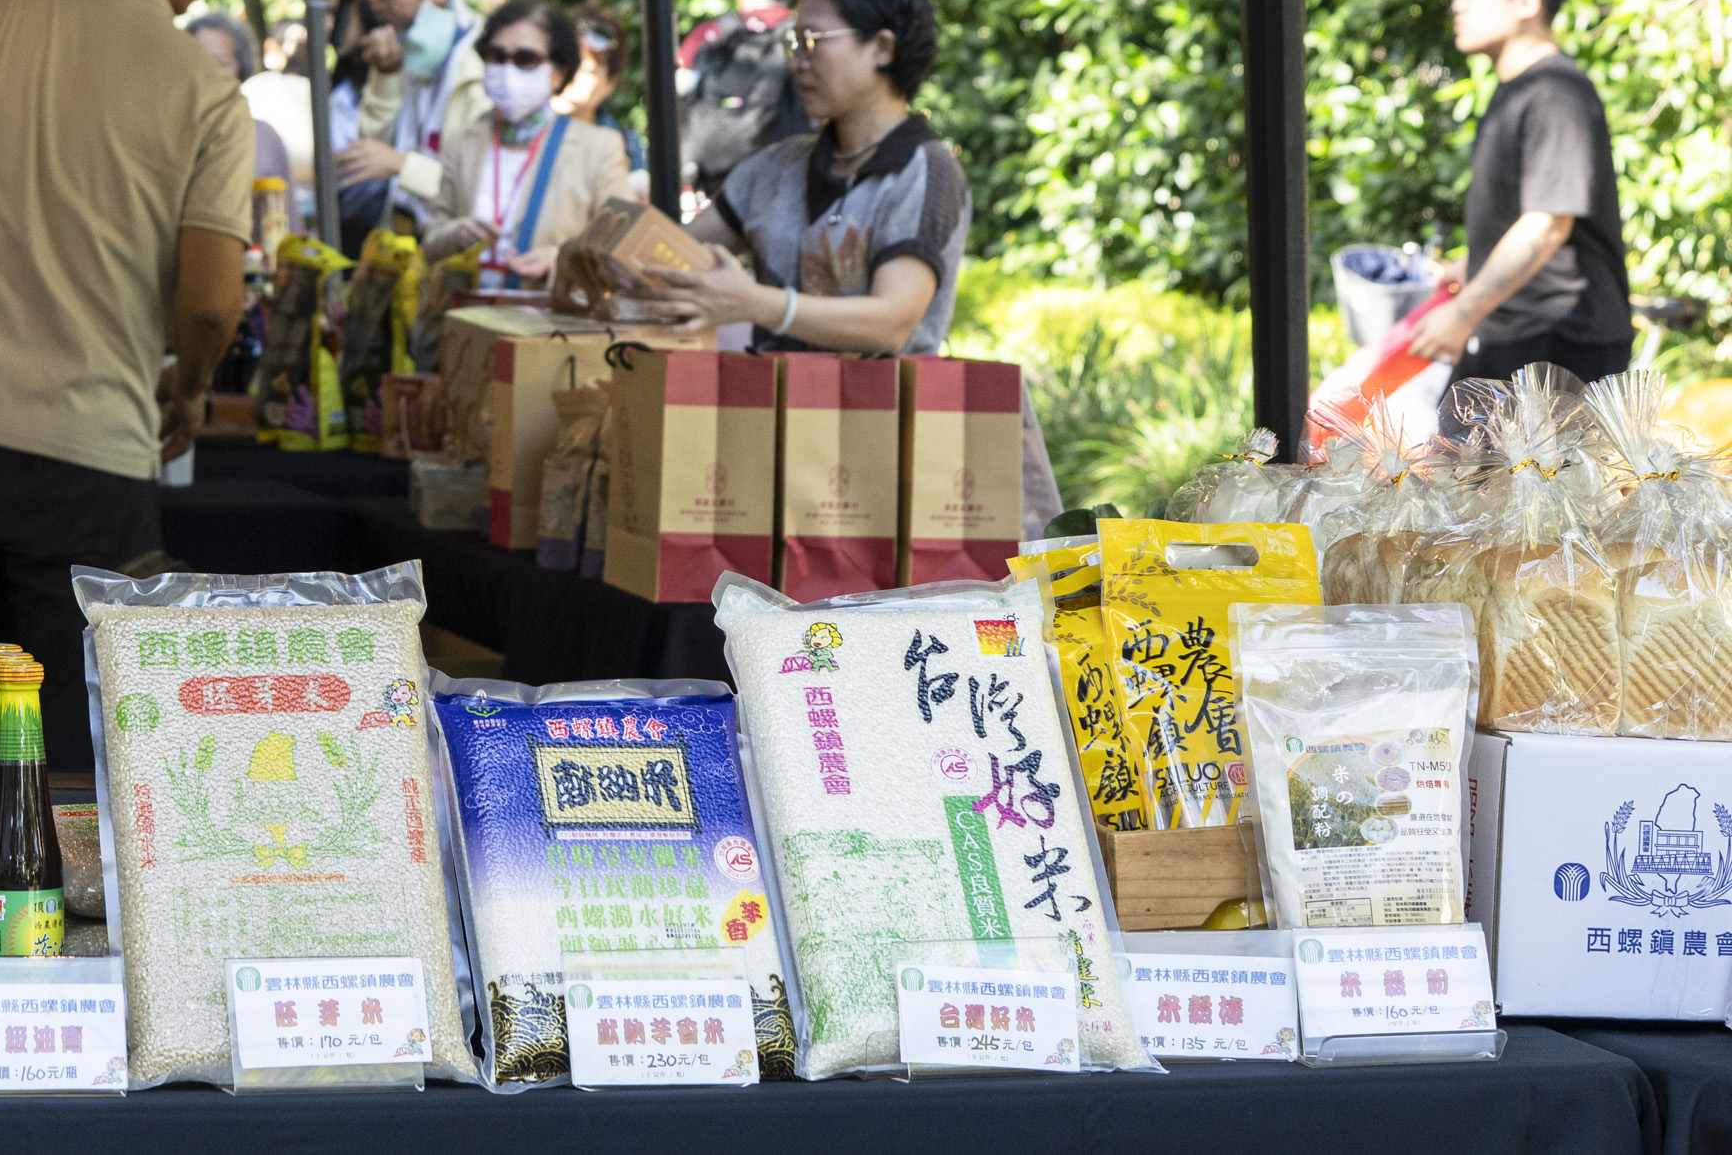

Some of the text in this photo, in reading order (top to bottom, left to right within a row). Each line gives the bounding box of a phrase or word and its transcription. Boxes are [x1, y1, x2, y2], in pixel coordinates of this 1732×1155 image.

[134, 627, 377, 668] 西螺鎮農會
[546, 716, 668, 741] 西螺鎮農會
[802, 686, 851, 795] 西螺鎮農會
[1305, 741, 1366, 753] 西螺鎮農會
[1155, 762, 1222, 789] SILUO
[1331, 764, 1354, 805] 米の
[1159, 781, 1230, 800] AGRICULTURE
[1311, 786, 1332, 838] 調配粉
[553, 873, 709, 899] 今日民間珍品
[955, 810, 1005, 939] CAS良質米
[1327, 945, 1478, 964] 雲林縣西螺鎮農會
[1586, 927, 1732, 957] 西螺鎮農會
[265, 972, 415, 992] 雲林縣西螺鎮農會
[927, 978, 1066, 1000] 雲林縣西螺鎮農會
[1135, 967, 1287, 986] 雲林縣西螺鎮農會
[1340, 968, 1449, 998] 米穀粉
[274, 997, 383, 1028] 胚芽米
[596, 994, 743, 1009] 雲林縣西螺鎮農會
[1157, 994, 1244, 1025] 米穀棒
[940, 1002, 1036, 1032] 台灣好米
